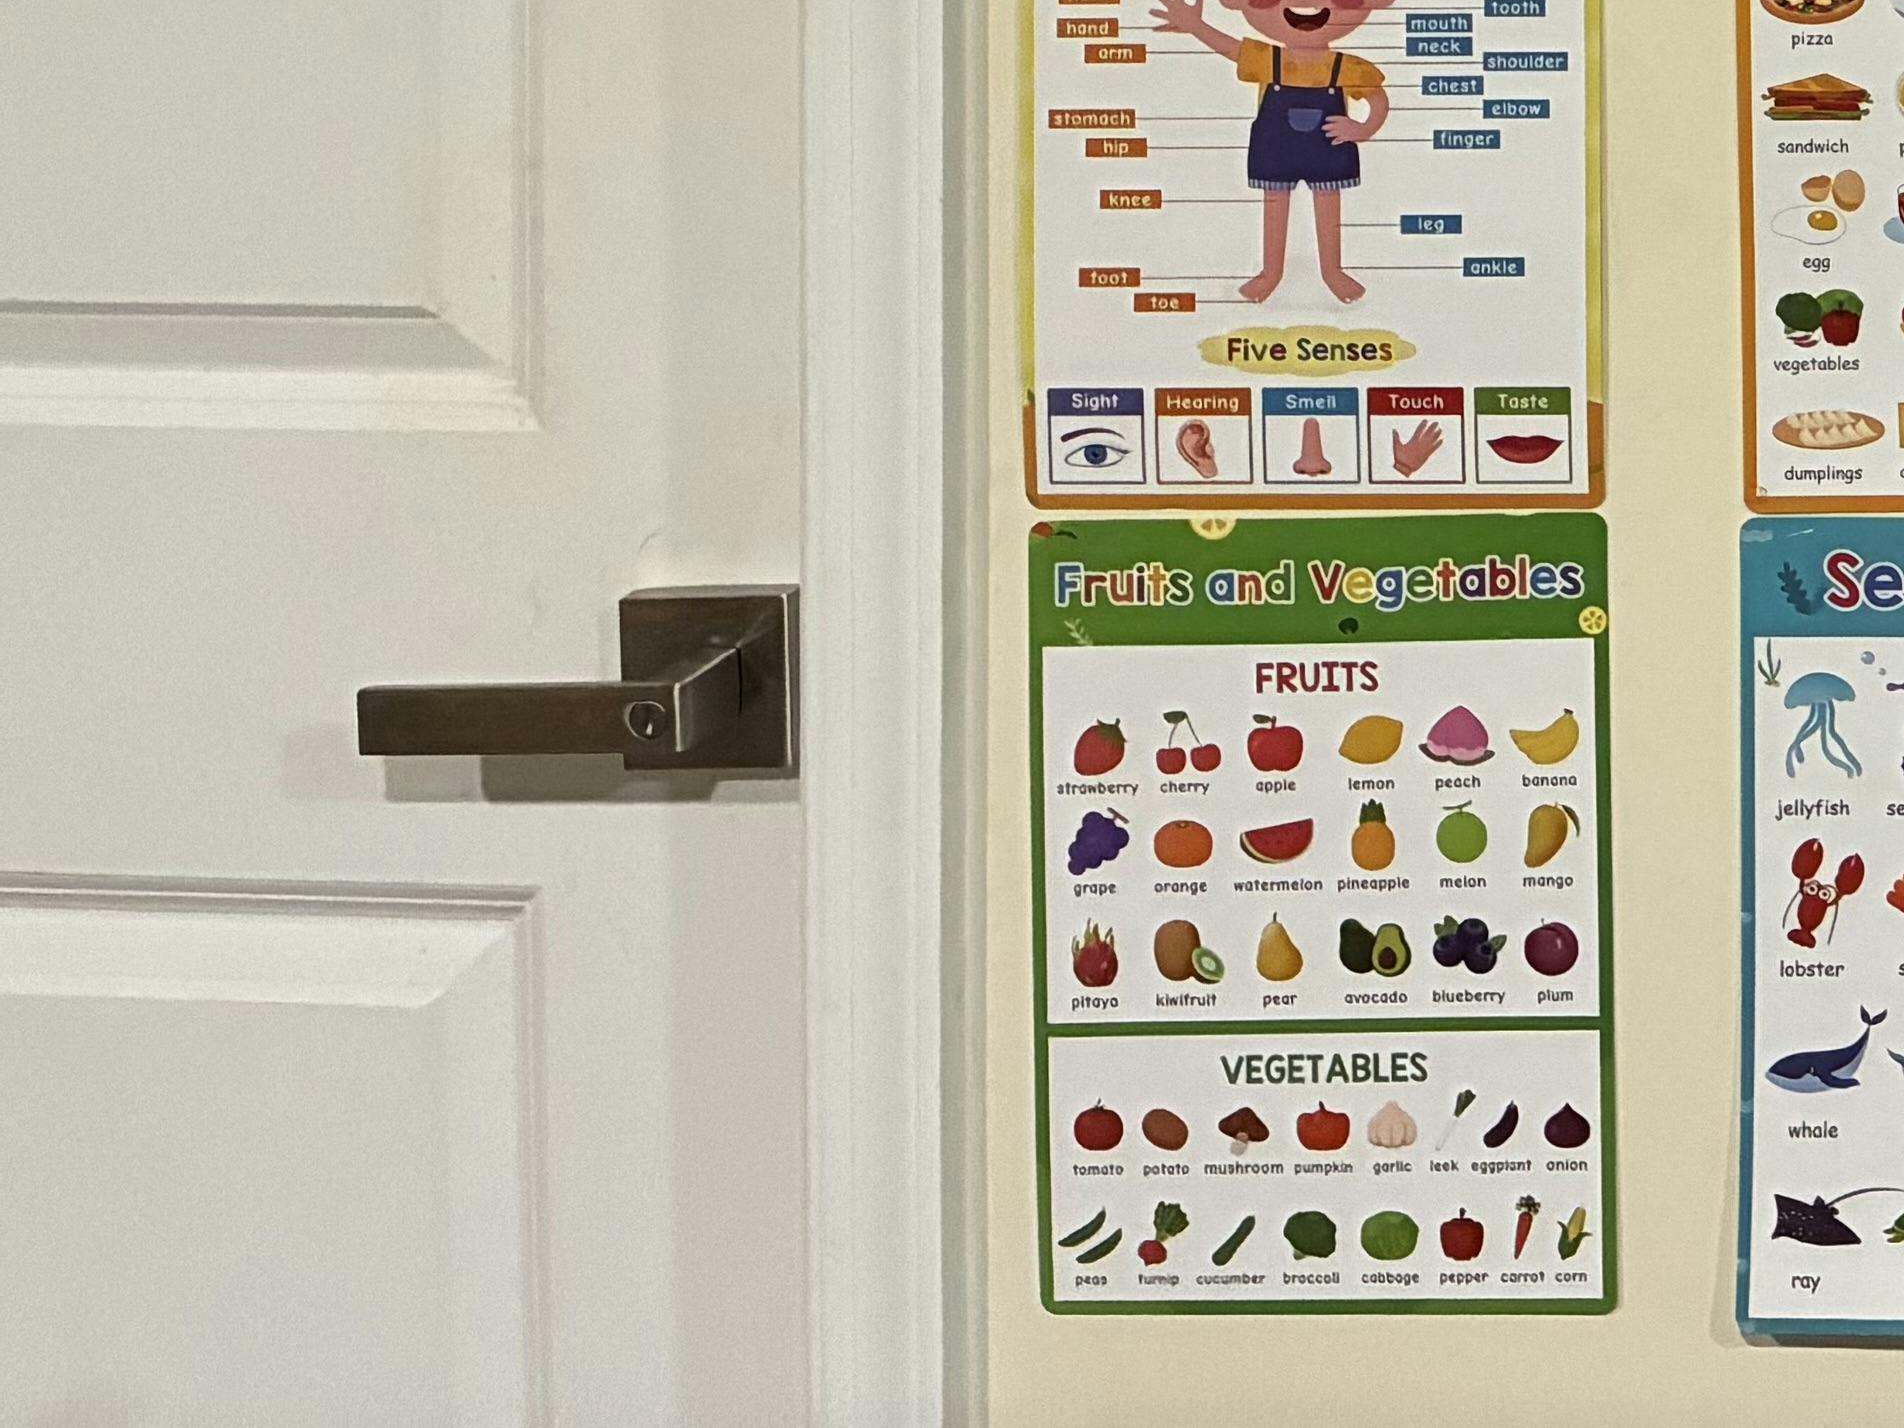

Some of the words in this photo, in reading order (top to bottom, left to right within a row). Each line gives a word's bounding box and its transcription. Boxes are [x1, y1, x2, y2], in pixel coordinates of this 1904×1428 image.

[1486, 53, 1565, 70] shoulder
[1227, 337, 1288, 362] Five
[1296, 338, 1393, 363] Senses
[1773, 356, 1860, 375] vegetables
[1166, 394, 1239, 412] Hearing
[1054, 562, 1193, 608] Fruits
[1206, 560, 1295, 605] and
[1308, 554, 1585, 612] Vegetables
[1255, 661, 1379, 694] FRUITS
[1348, 776, 1395, 791] lemon
[1220, 1051, 1429, 1085] VEGETABLES
